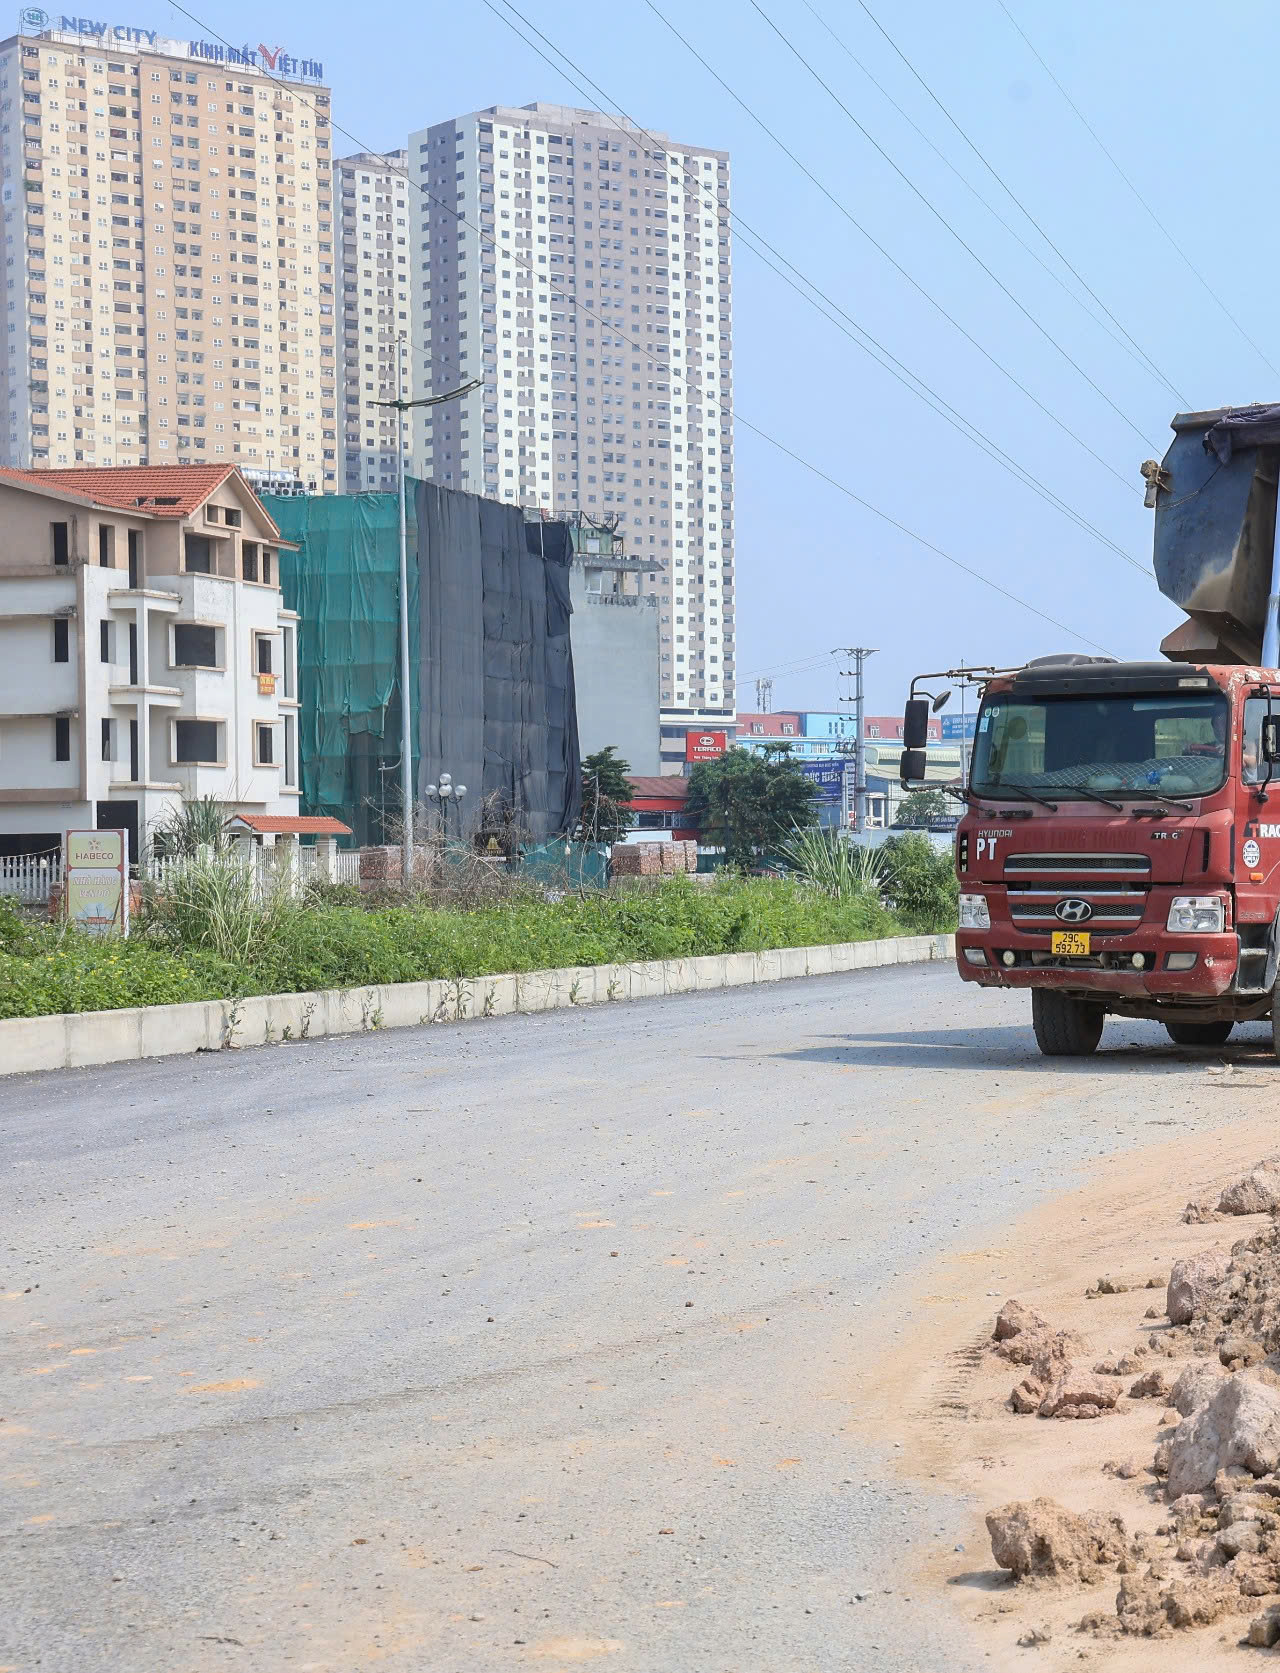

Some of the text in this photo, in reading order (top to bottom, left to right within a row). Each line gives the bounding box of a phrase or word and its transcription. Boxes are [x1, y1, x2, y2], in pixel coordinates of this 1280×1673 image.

[61, 15, 157, 46] NEW CITY
[190, 40, 224, 61] KÍNH
[75, 852, 114, 860] HABECO
[976, 837, 998, 861] PT
[1062, 933, 1079, 943] 29C
[1055, 943, 1086, 954] 592.73
